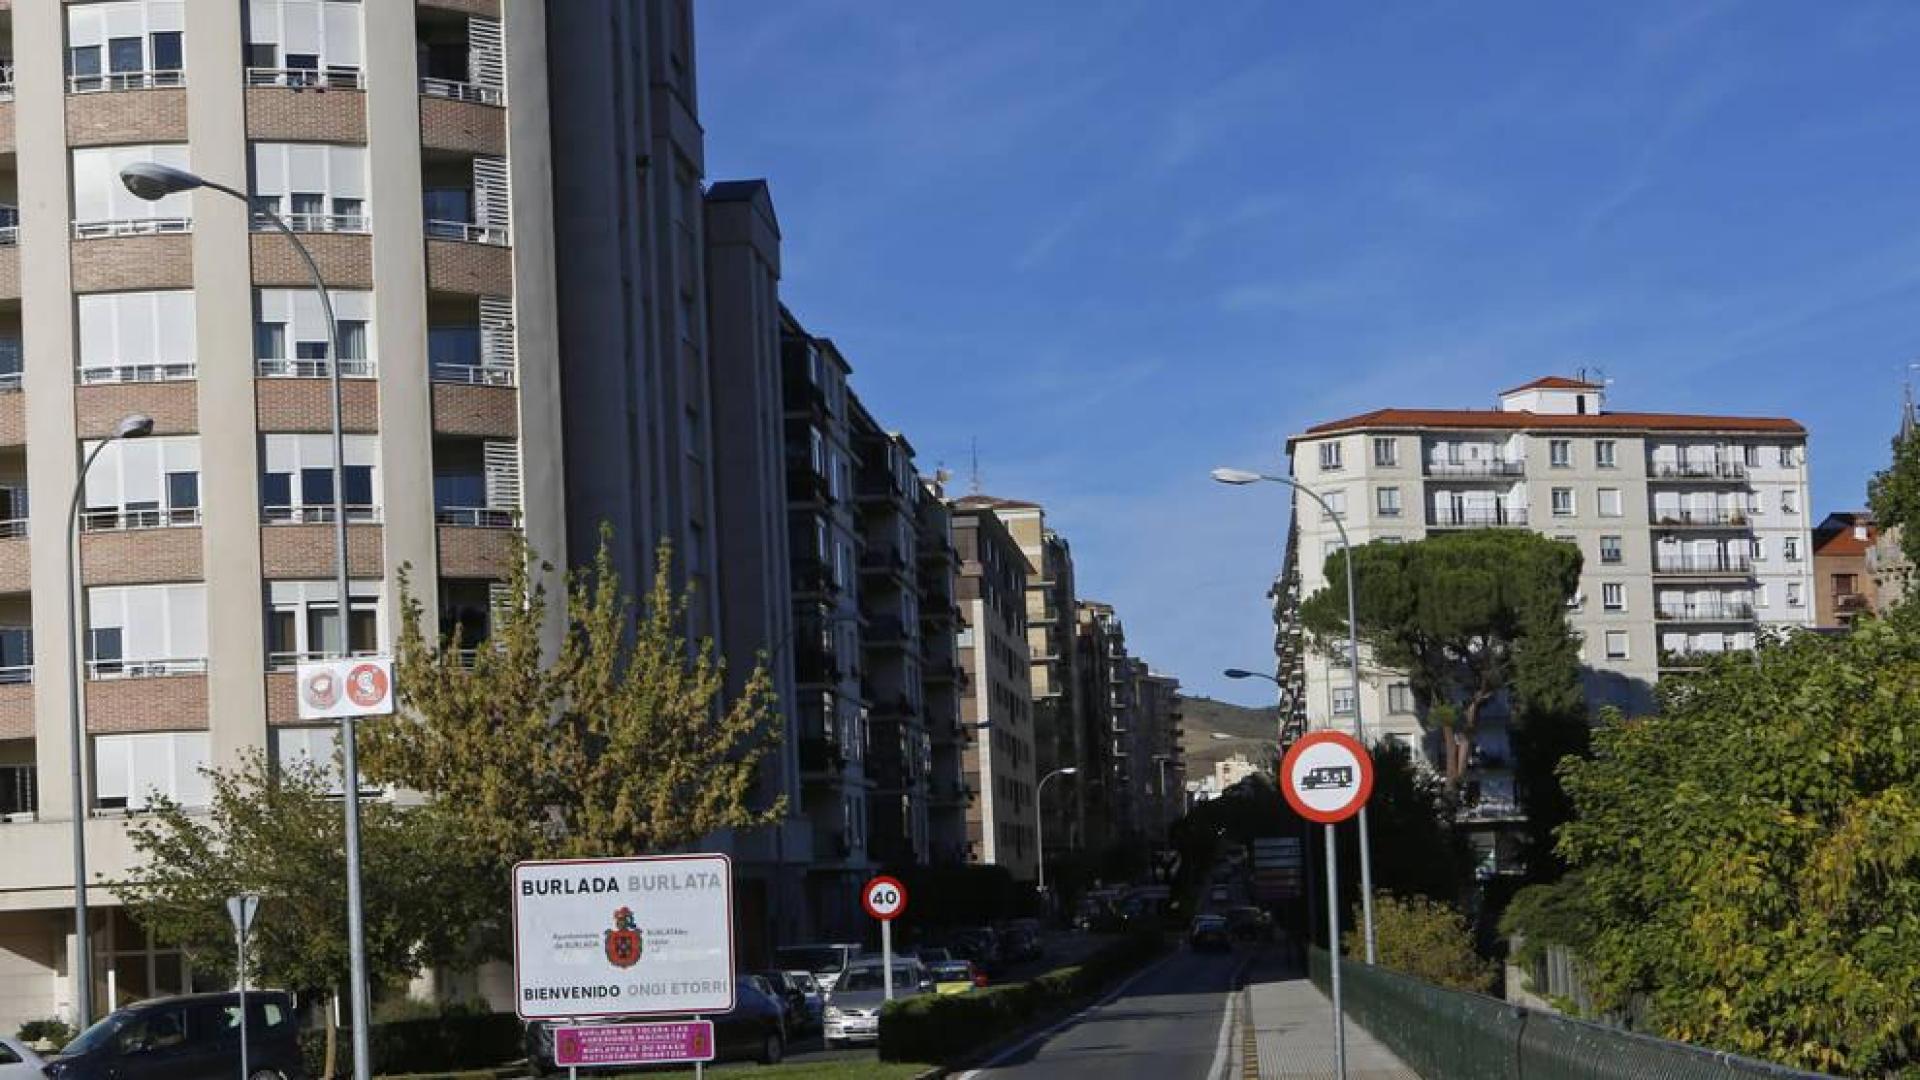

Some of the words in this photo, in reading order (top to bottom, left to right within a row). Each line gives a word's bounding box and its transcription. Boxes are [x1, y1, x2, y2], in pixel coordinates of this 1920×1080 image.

[521, 877, 619, 897] BURLADA
[628, 873, 721, 892] BURLATA
[872, 890, 897, 904] 40
[524, 984, 620, 1001] BIENVENIDO
[627, 982, 666, 997] ONGI
[670, 979, 728, 996] ETORRI
